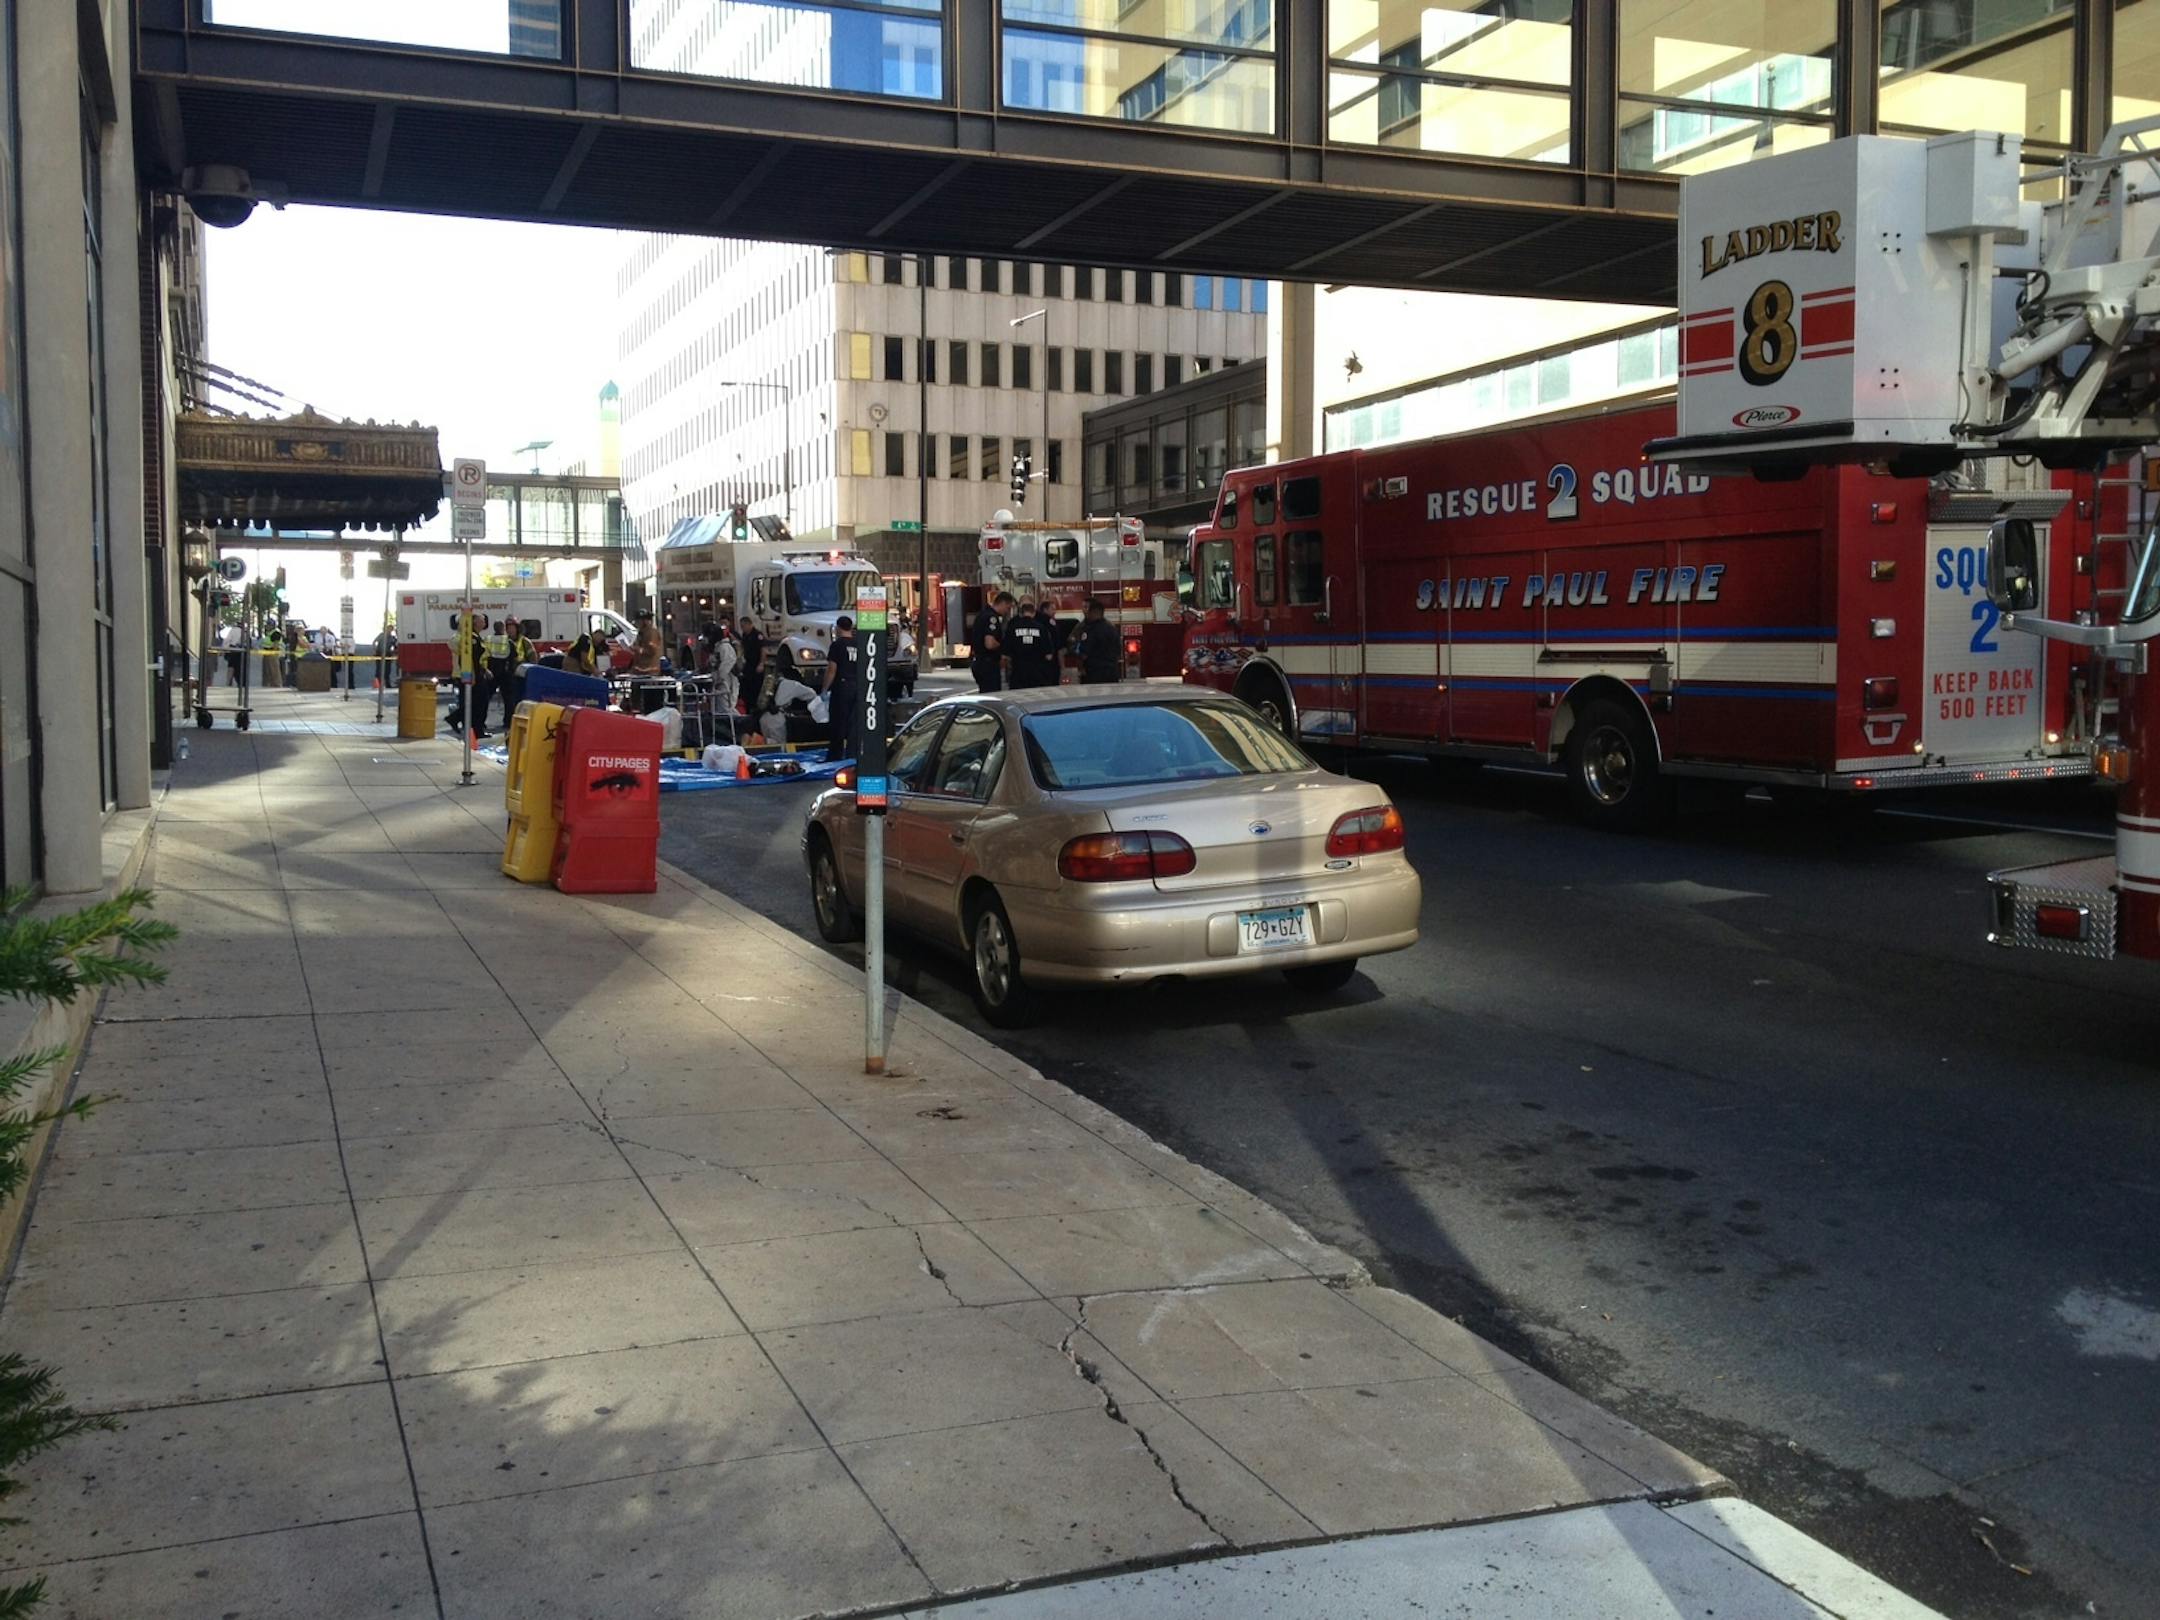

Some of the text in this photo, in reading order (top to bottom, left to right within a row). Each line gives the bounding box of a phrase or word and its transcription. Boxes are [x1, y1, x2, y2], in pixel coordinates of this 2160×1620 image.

[1701, 210, 1842, 280] LADDER
[1739, 280, 1797, 386] 8
[1746, 406, 1785, 424] Pierce
[1426, 463, 1711, 521] RESCUE 2 SQUAD
[1415, 563, 1725, 610] SAINT PAUL FIRE
[1970, 600, 2000, 653] 2
[865, 633, 877, 730] 6648
[1933, 668, 2034, 694] KEEP BACK
[1940, 694, 2027, 720] 500 FEET
[1243, 920, 1269, 941] 729
[1278, 915, 1303, 937] GZY
